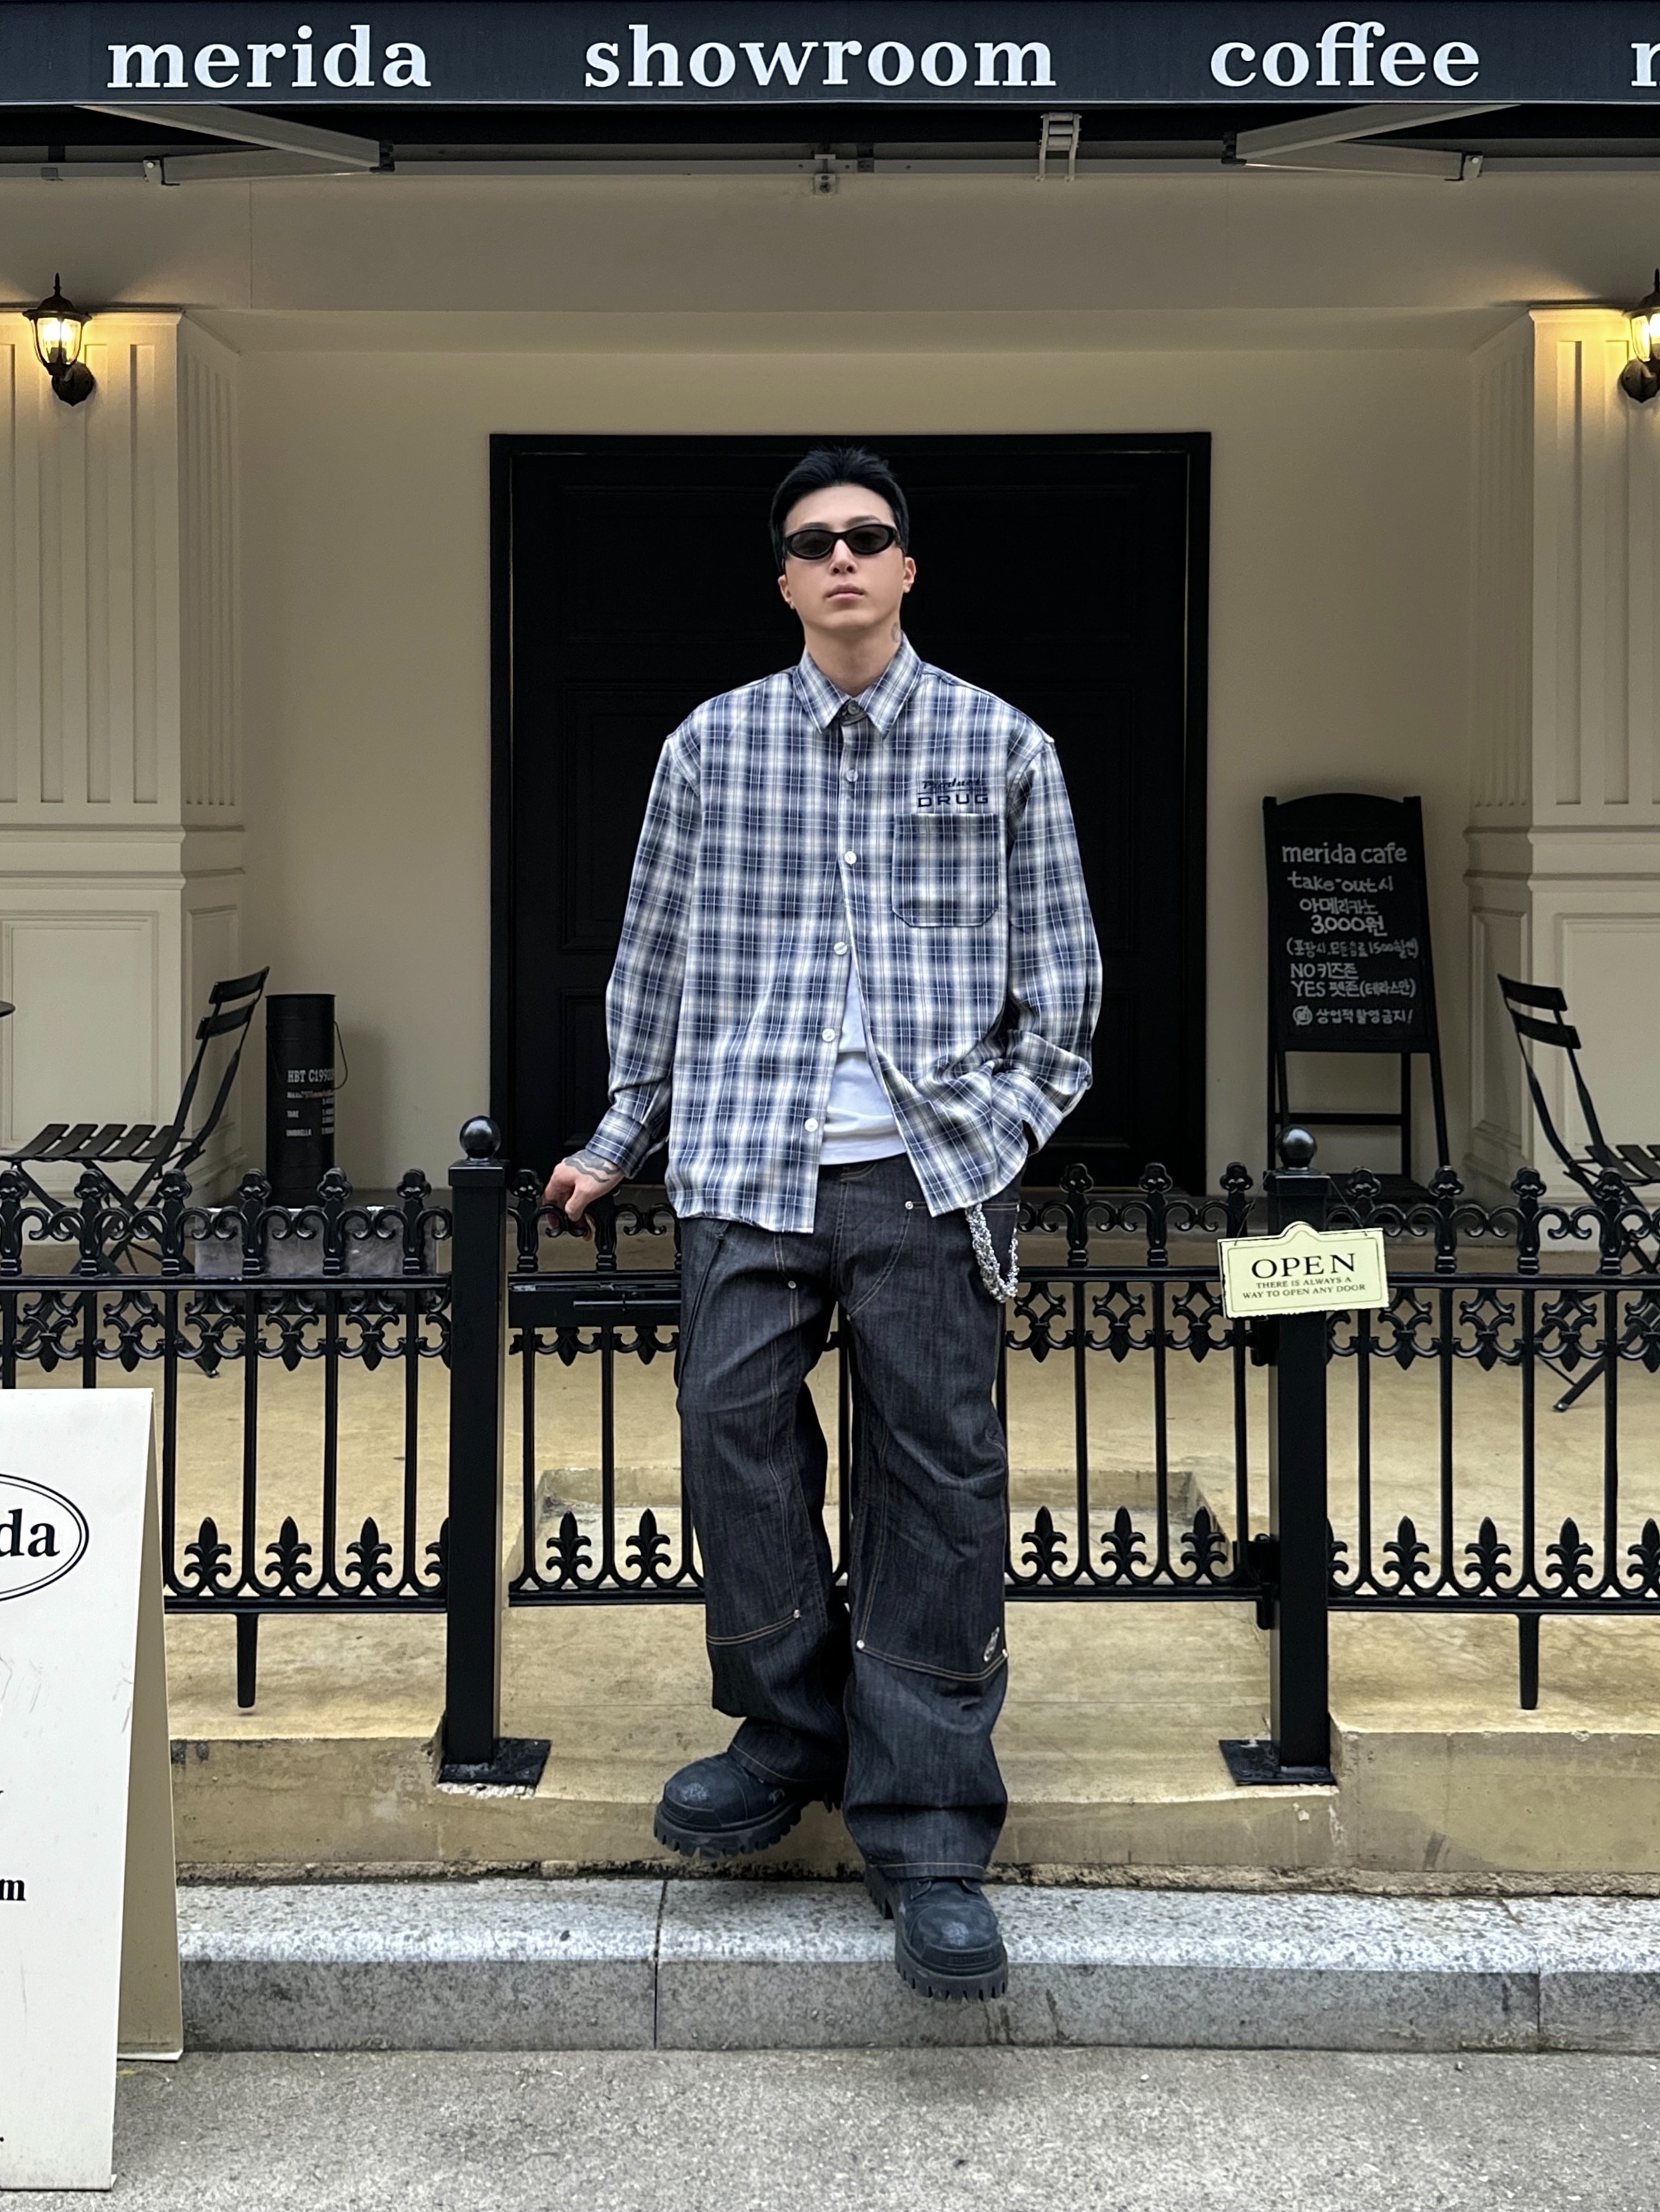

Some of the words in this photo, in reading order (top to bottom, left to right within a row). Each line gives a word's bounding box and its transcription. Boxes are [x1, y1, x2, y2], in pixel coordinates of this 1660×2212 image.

[107, 25, 431, 88] merida
[586, 24, 1057, 88] showroom
[1210, 21, 1480, 87] coffee
[918, 794, 988, 807] DRUG
[1282, 841, 1356, 864] merida
[1361, 841, 1407, 864] cafe
[1299, 897, 1379, 915] 아메리카노
[1317, 962, 1359, 979] 키즈존
[1291, 980, 1325, 997] YES
[288, 1070, 305, 1083] HBT
[1252, 1253, 1355, 1278] OPEN
[1256, 1280, 1289, 1289] THERE
[1303, 1277, 1342, 1285] ALWAYS
[1282, 1288, 1309, 1296] OPEN
[1336, 1284, 1365, 1292] DOOR
